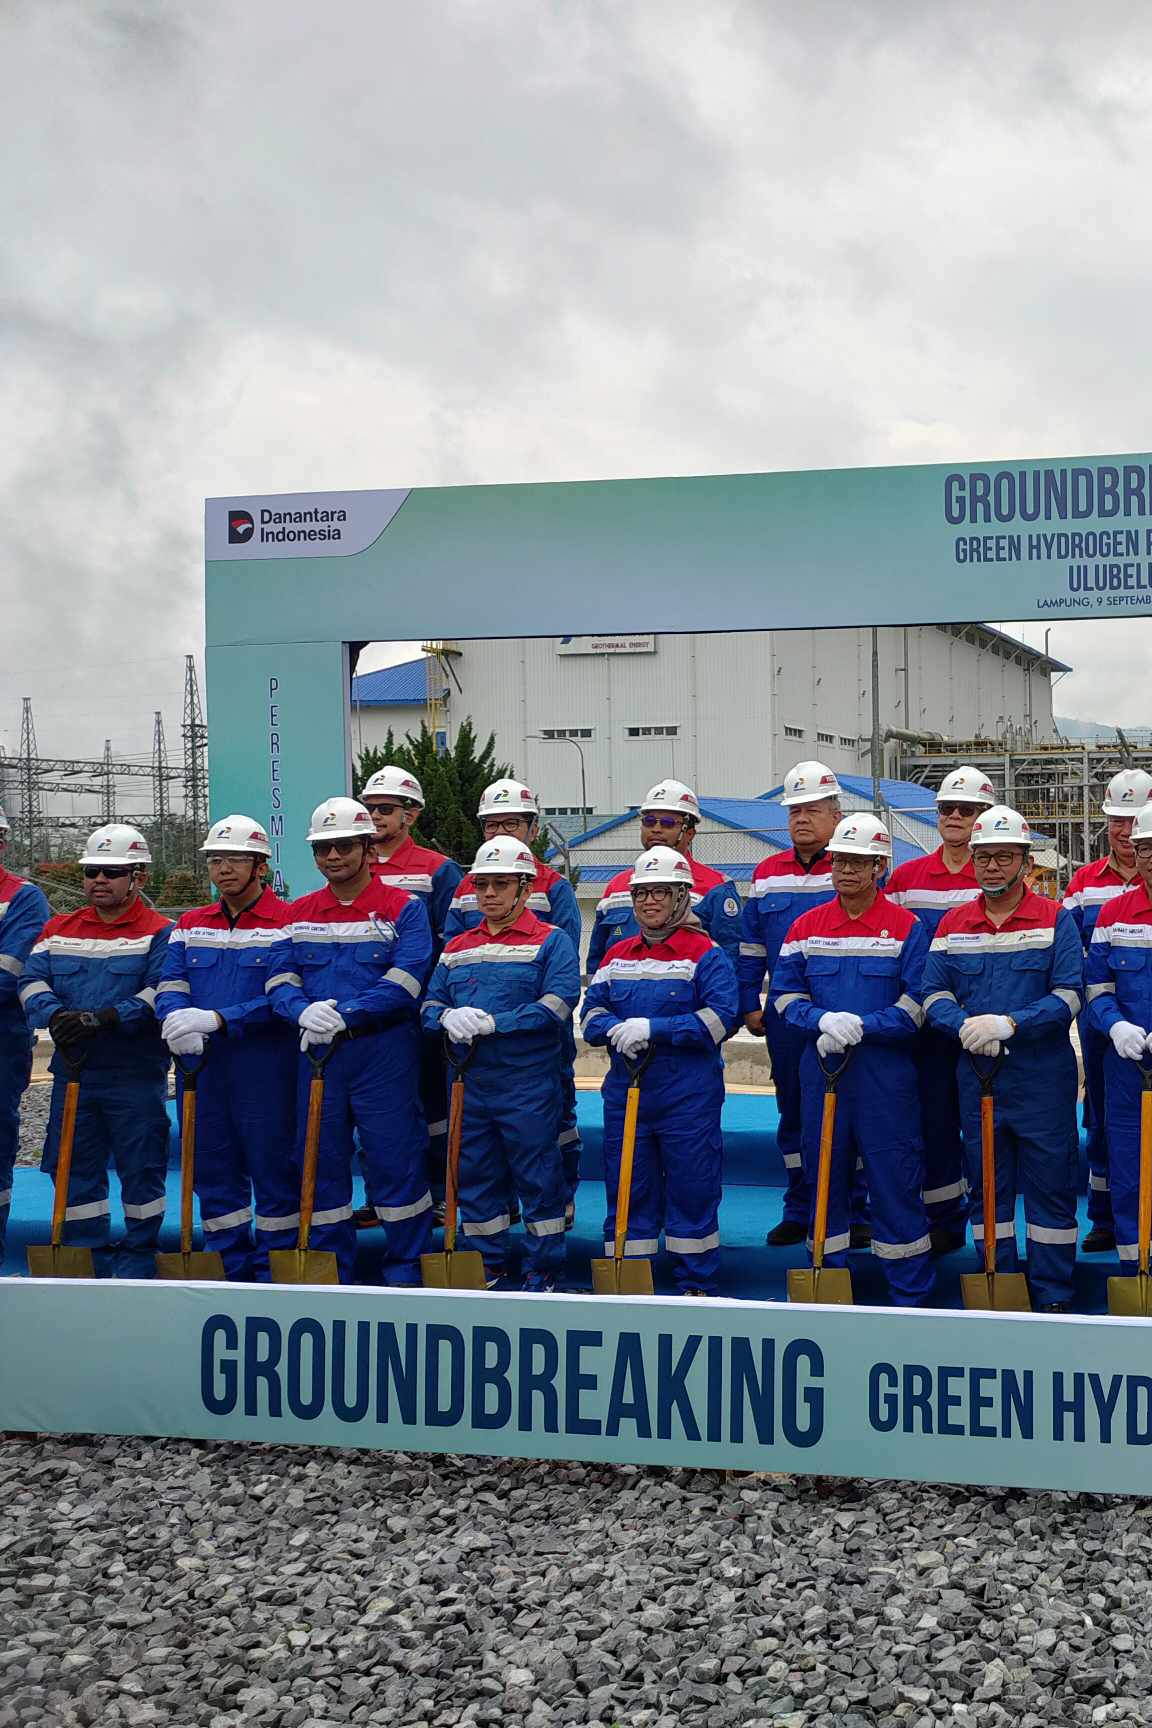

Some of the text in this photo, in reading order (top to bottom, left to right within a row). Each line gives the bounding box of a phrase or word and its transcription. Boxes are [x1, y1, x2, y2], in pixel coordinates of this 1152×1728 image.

[260, 507, 347, 525] Danantara
[260, 525, 341, 543] Indonesia
[955, 534, 1022, 564] GREEN
[1028, 529, 1139, 561] HYDROGEN
[1037, 597, 1094, 609] LAMPUNG,
[1096, 597, 1104, 607] 9
[269, 677, 286, 900] PERESMIA
[201, 1313, 825, 1449] GROUNDBREAKING
[868, 1362, 1034, 1440] GREEN
